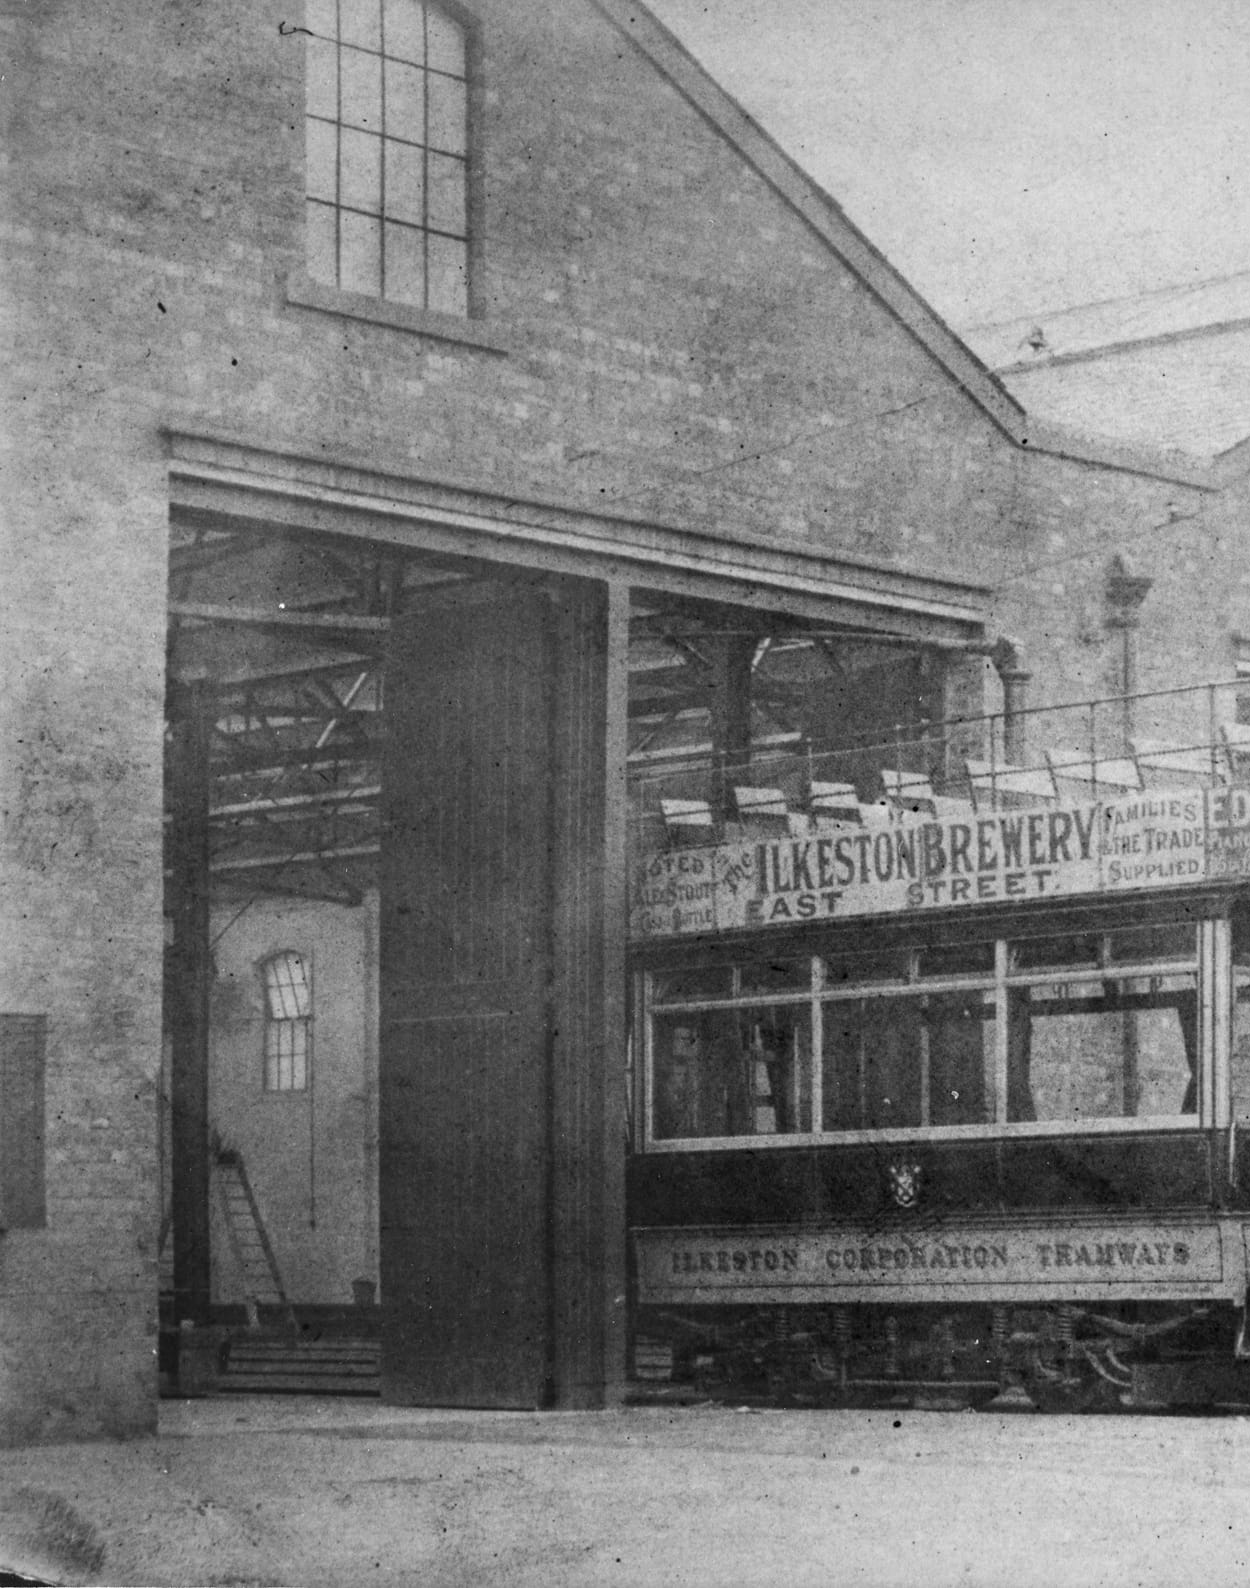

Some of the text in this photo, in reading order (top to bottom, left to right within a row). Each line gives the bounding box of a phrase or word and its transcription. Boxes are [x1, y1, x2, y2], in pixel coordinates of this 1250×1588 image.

[1104, 800, 1197, 834] FAMILIES
[757, 806, 1097, 895] ILKESTON BREWERY
[1113, 833, 1141, 855] THE
[1143, 827, 1203, 856] TRADE
[1109, 859, 1199, 885] SUPPLIED
[747, 891, 843, 925] EAST
[672, 1242, 1191, 1273] ILKESTON CORPORATION TRAMWAYS
